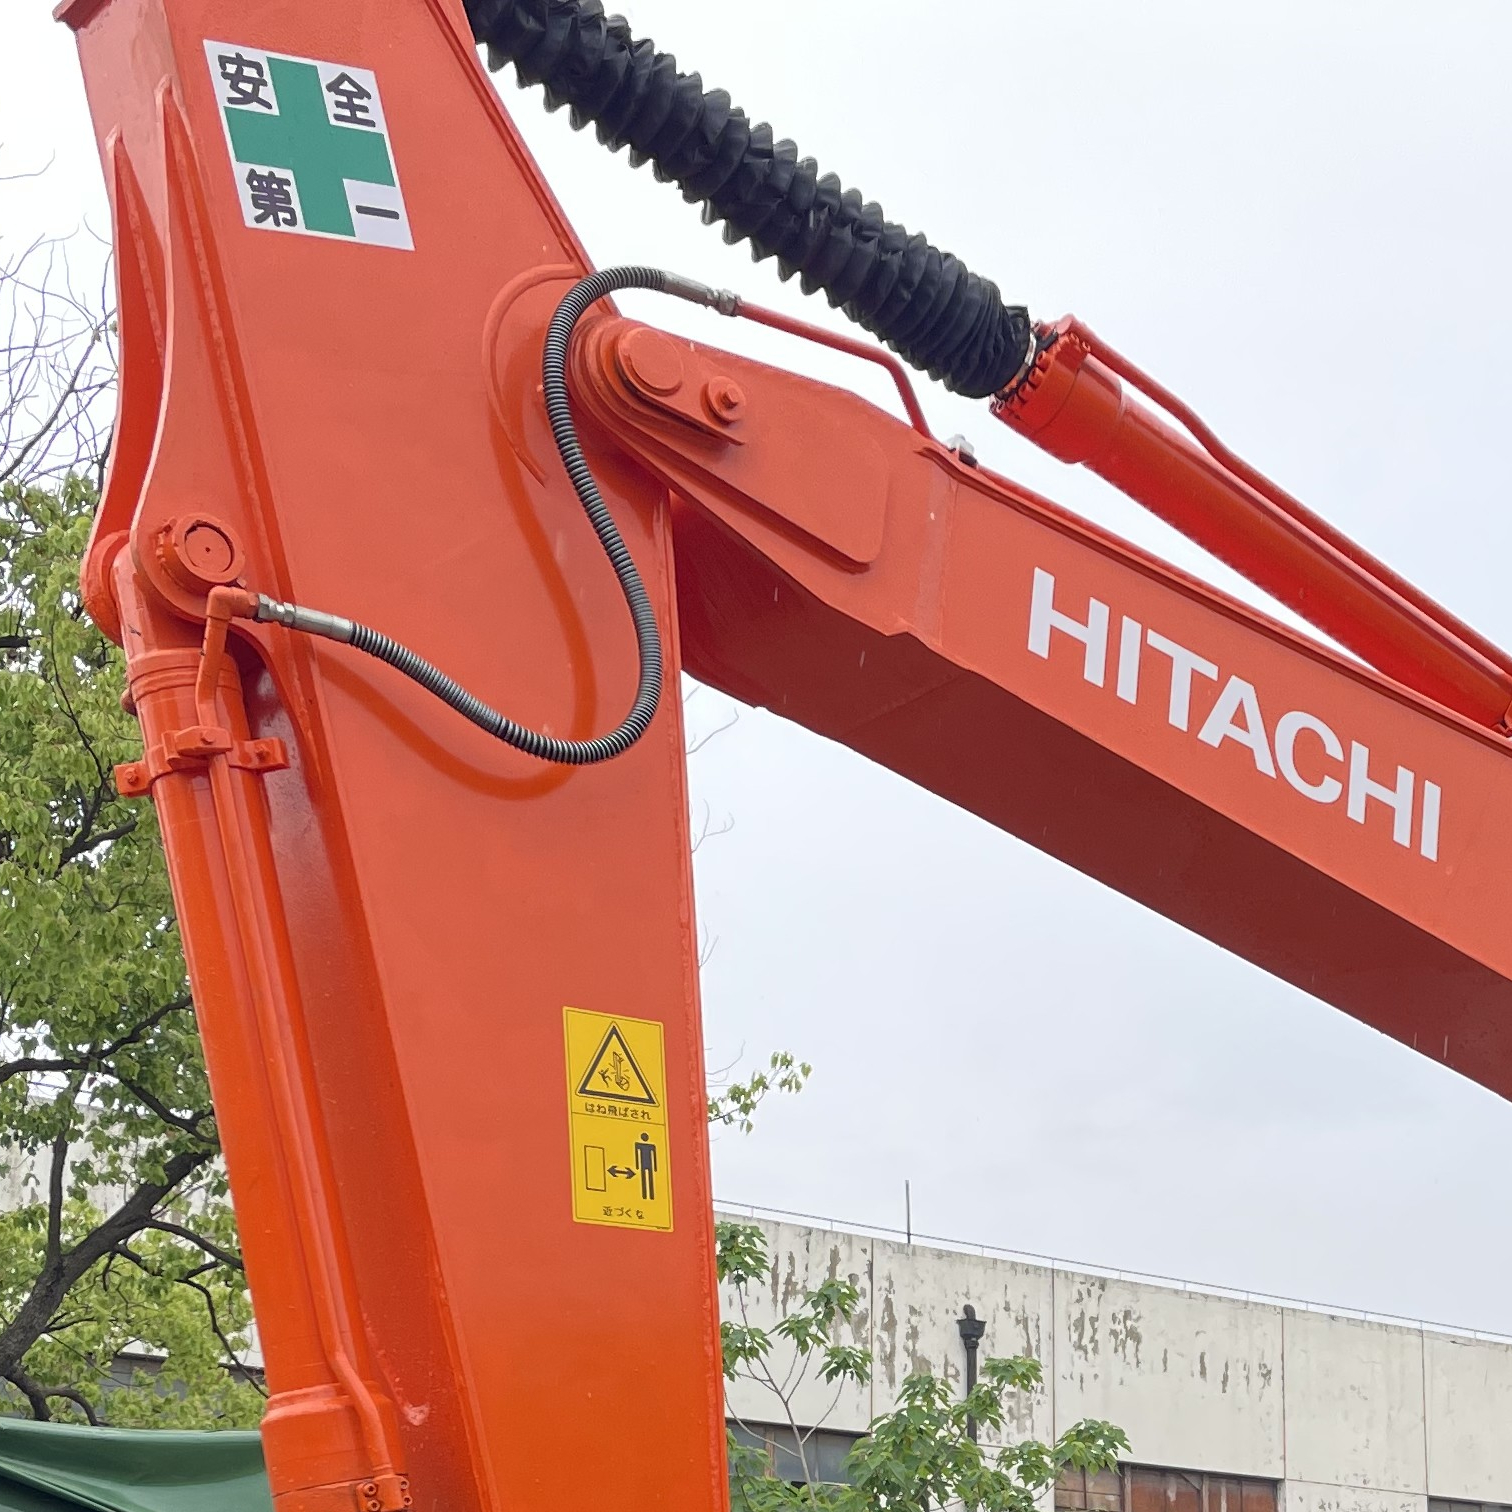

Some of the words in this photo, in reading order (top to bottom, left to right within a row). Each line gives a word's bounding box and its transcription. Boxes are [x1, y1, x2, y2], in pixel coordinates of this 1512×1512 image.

[1027, 566, 1442, 863] HITACHI
[585, 1102, 651, 1120] はね飛ばされ
